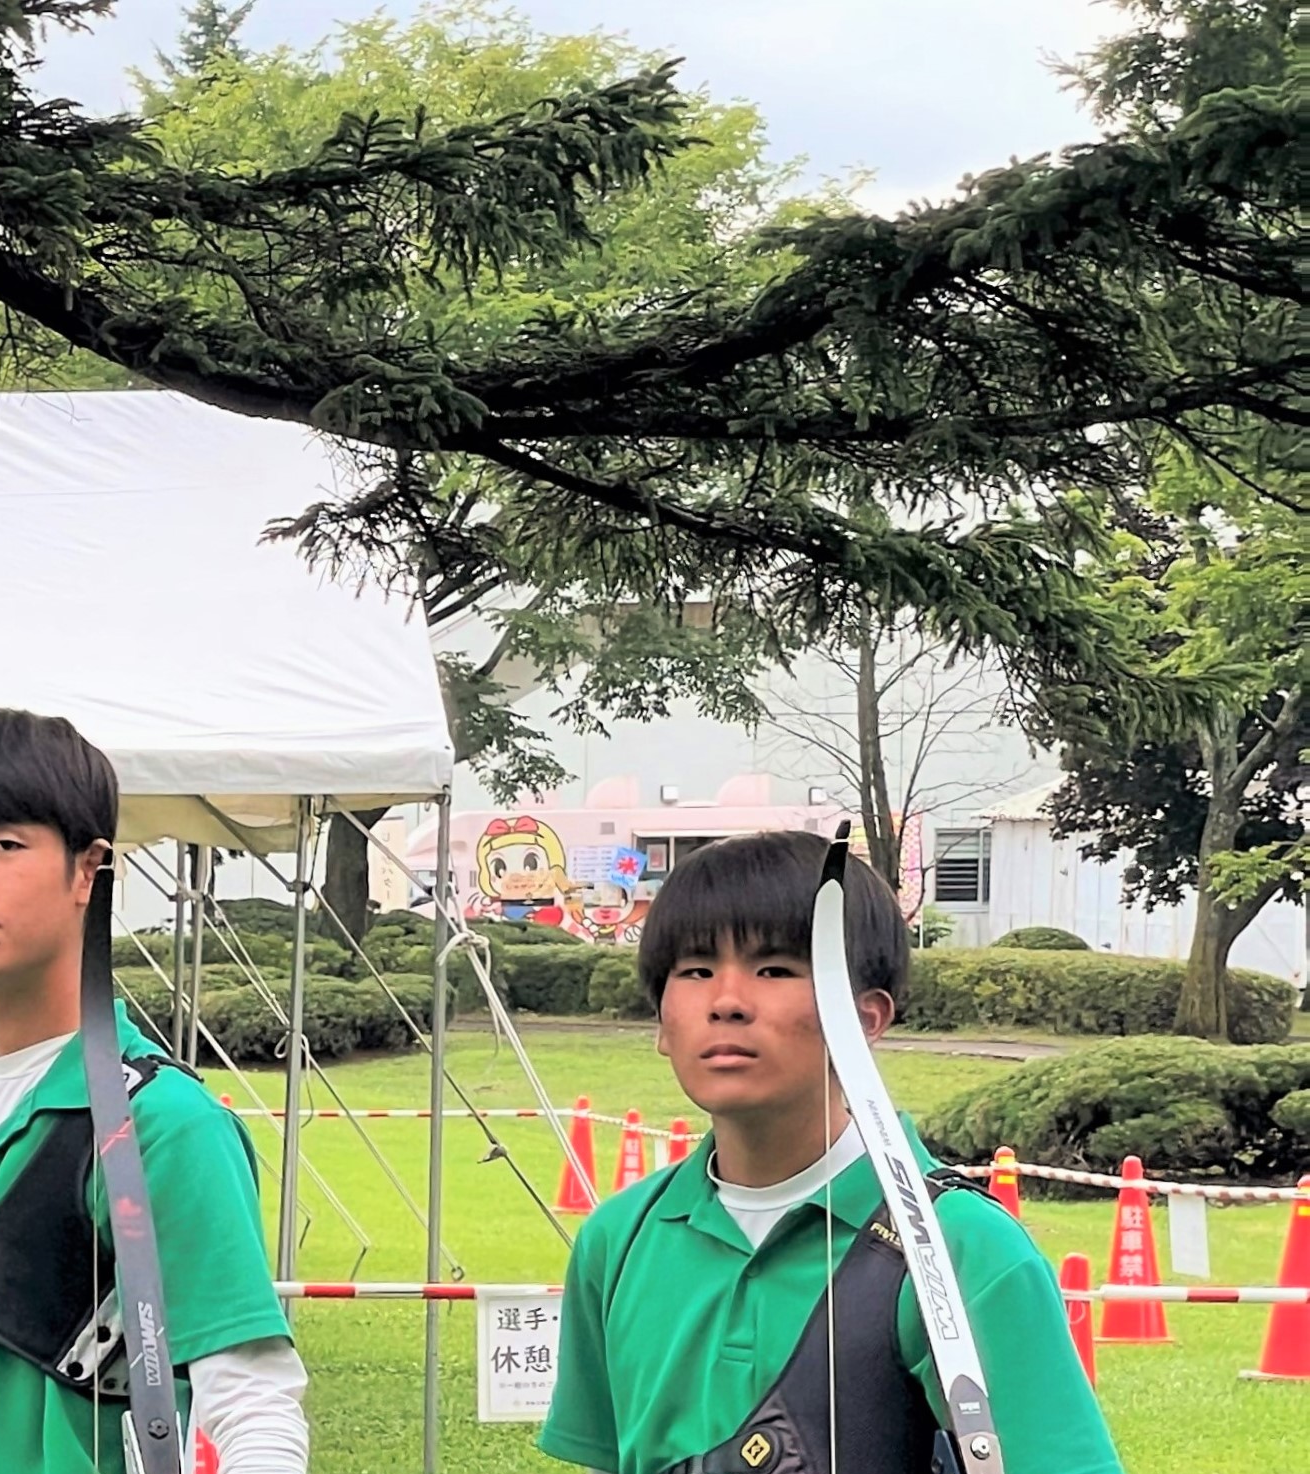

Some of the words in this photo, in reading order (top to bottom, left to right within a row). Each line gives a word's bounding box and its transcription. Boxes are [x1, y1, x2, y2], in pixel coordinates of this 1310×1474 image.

[1119, 1205, 1144, 1285] 駐車禁
[138, 1301, 161, 1386] WIAWIS
[491, 1344, 552, 1374] 休憩
